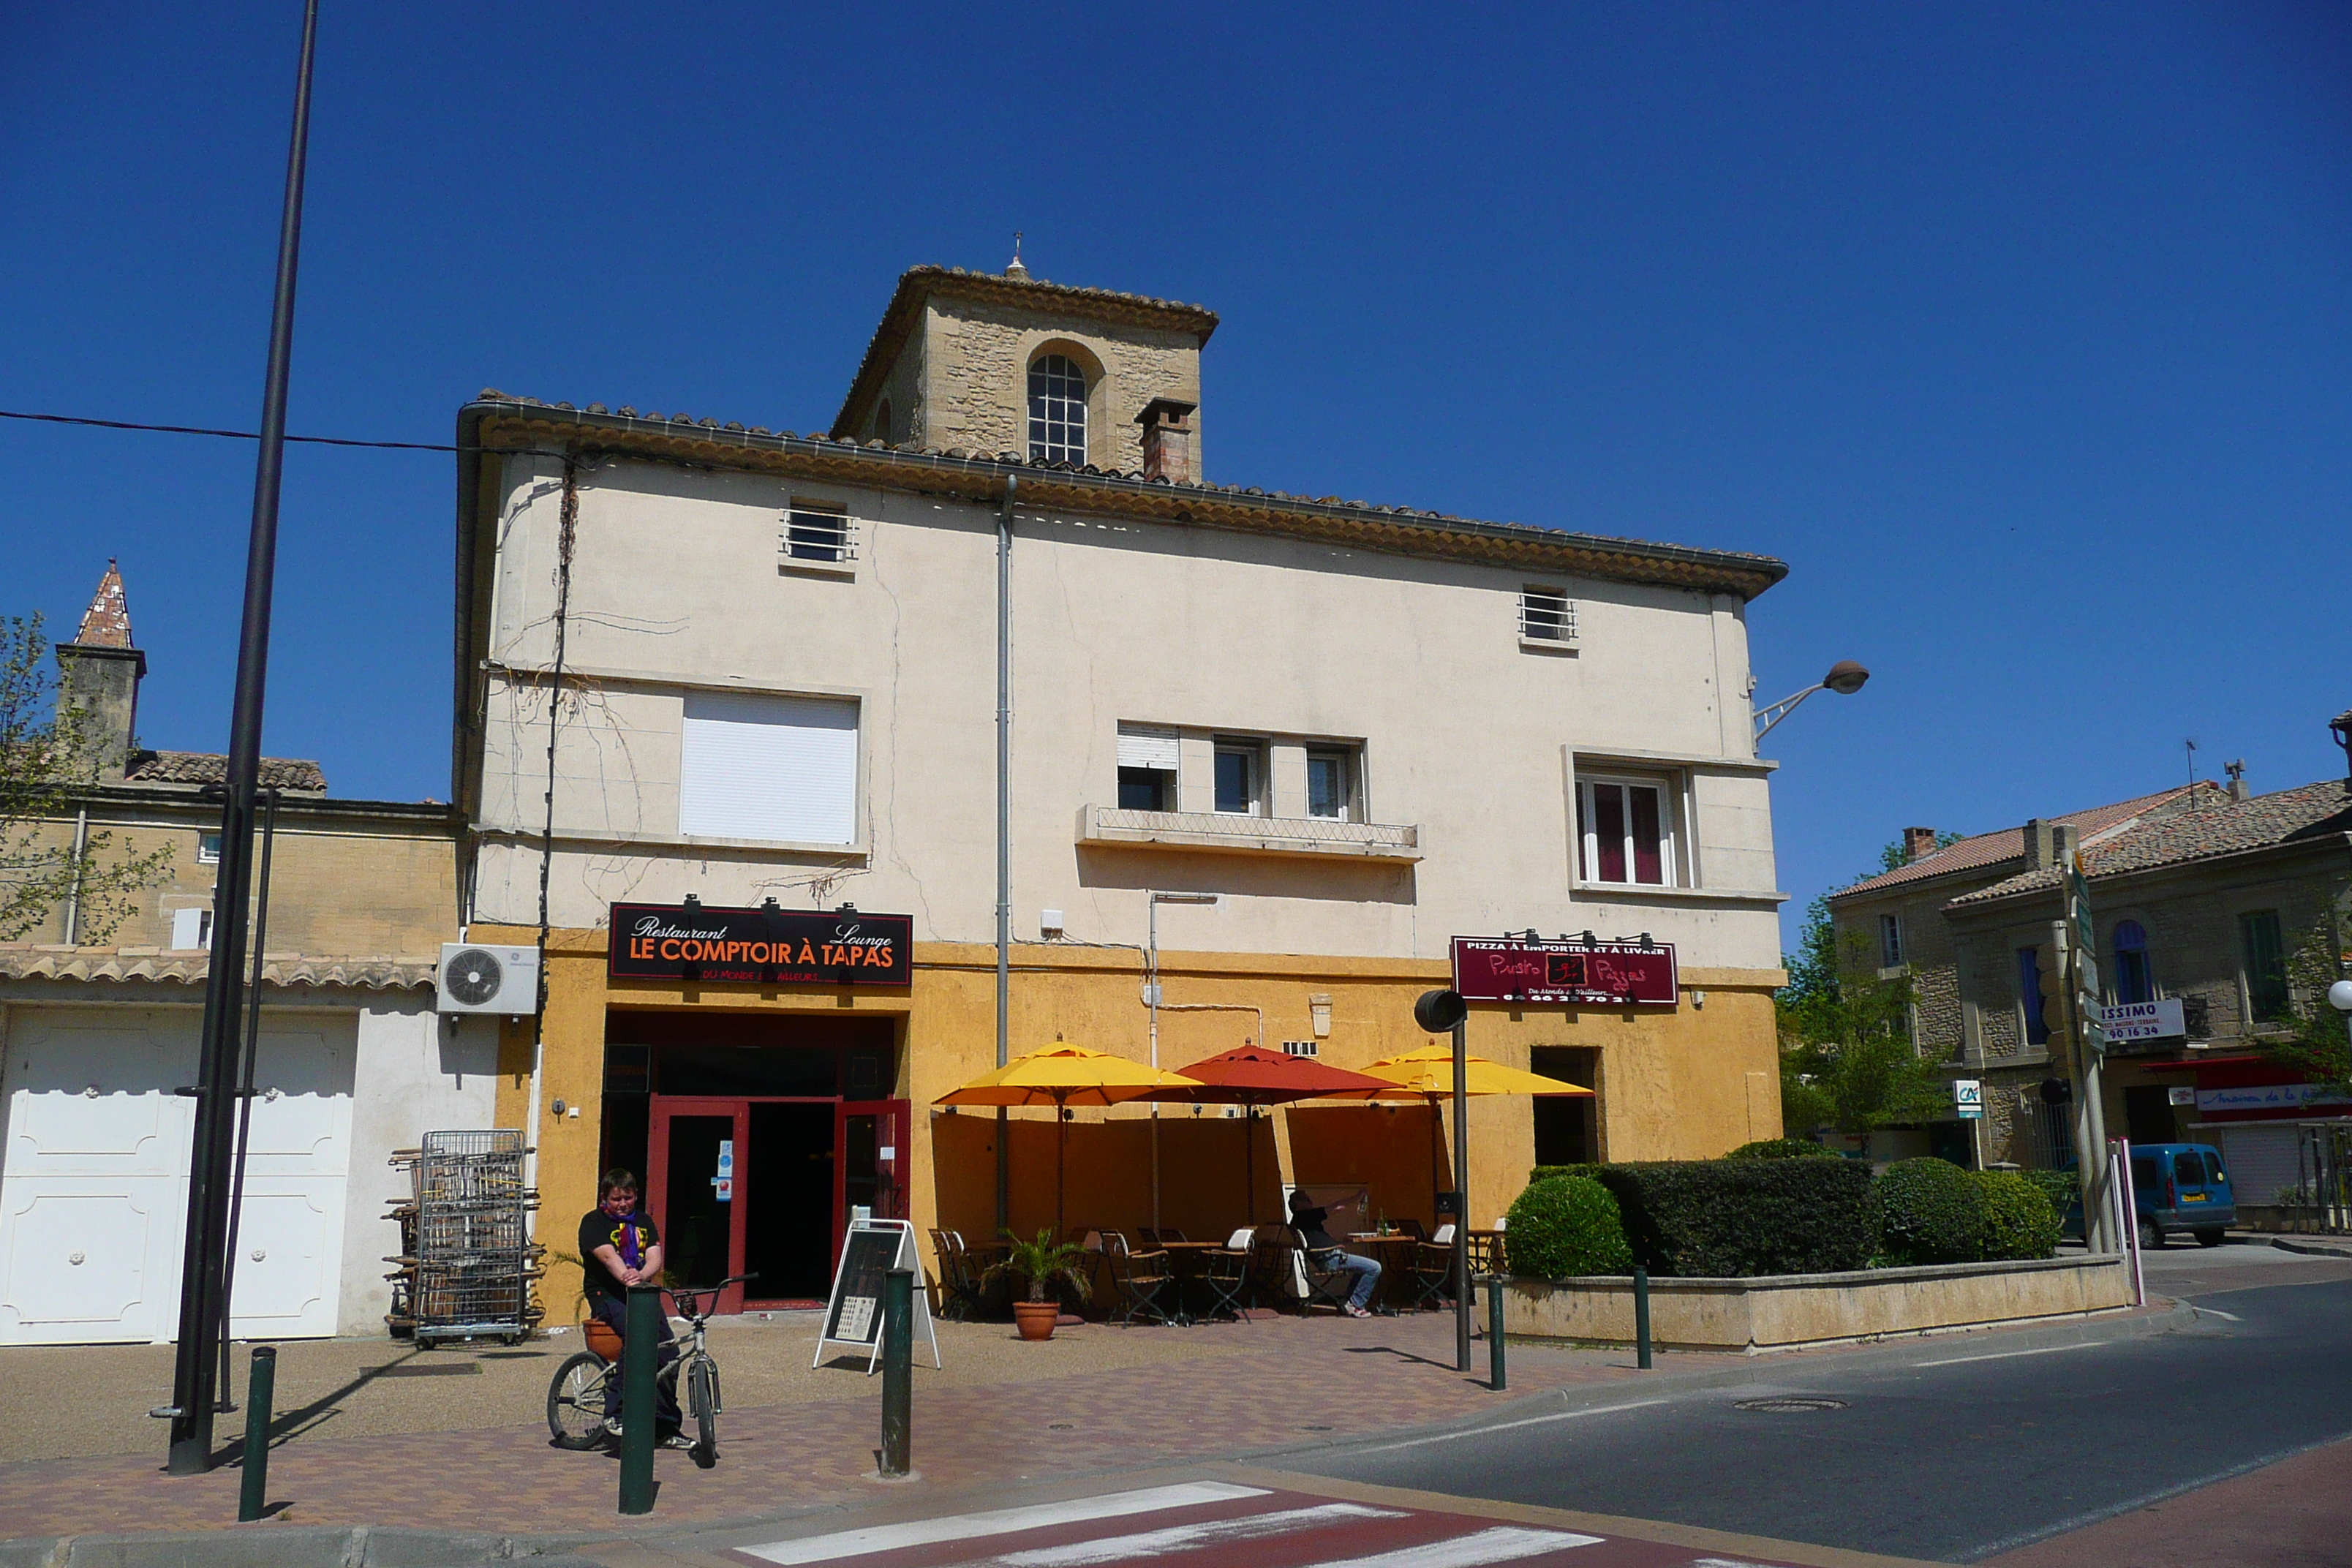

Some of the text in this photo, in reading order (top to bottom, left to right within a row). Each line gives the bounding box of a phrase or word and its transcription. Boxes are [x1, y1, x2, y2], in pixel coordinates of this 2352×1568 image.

[630, 916, 728, 939] Restaurant
[829, 924, 892, 951] Lounge
[630, 937, 894, 968] LE COMPTOIR À TAPAS
[1466, 942, 1506, 950] PIZZA
[1509, 942, 1519, 951] À
[1523, 944, 1589, 953] EMPORTER
[1610, 946, 1620, 954] À
[703, 970, 717, 978] DU
[720, 970, 754, 980] MONDE
[1489, 954, 1540, 976] Presto
[2109, 1026, 2158, 1039] 90 16 34
